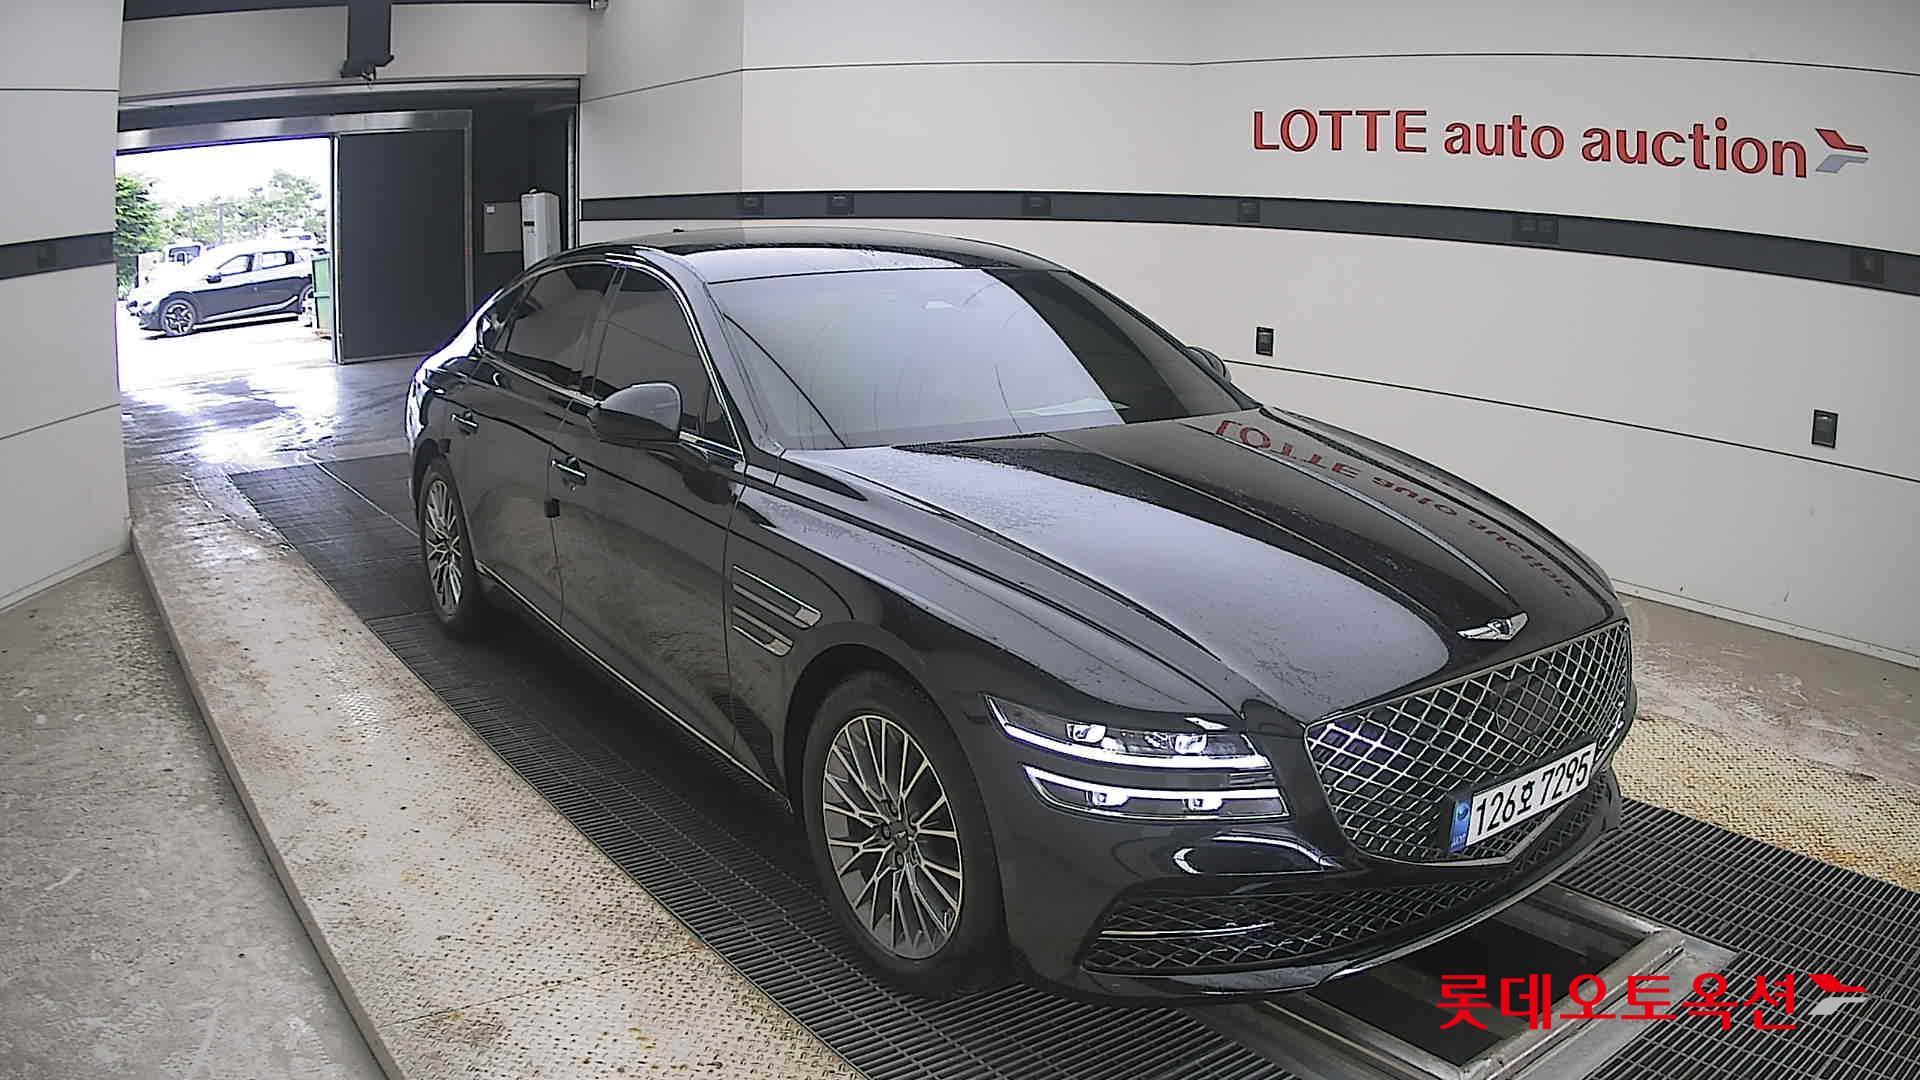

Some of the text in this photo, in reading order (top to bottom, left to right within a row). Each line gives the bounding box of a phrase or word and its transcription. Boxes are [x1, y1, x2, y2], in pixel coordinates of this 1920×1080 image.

[1253, 109, 1808, 179] LOTTE auto auction
[1476, 750, 1592, 836] 126호 7295
